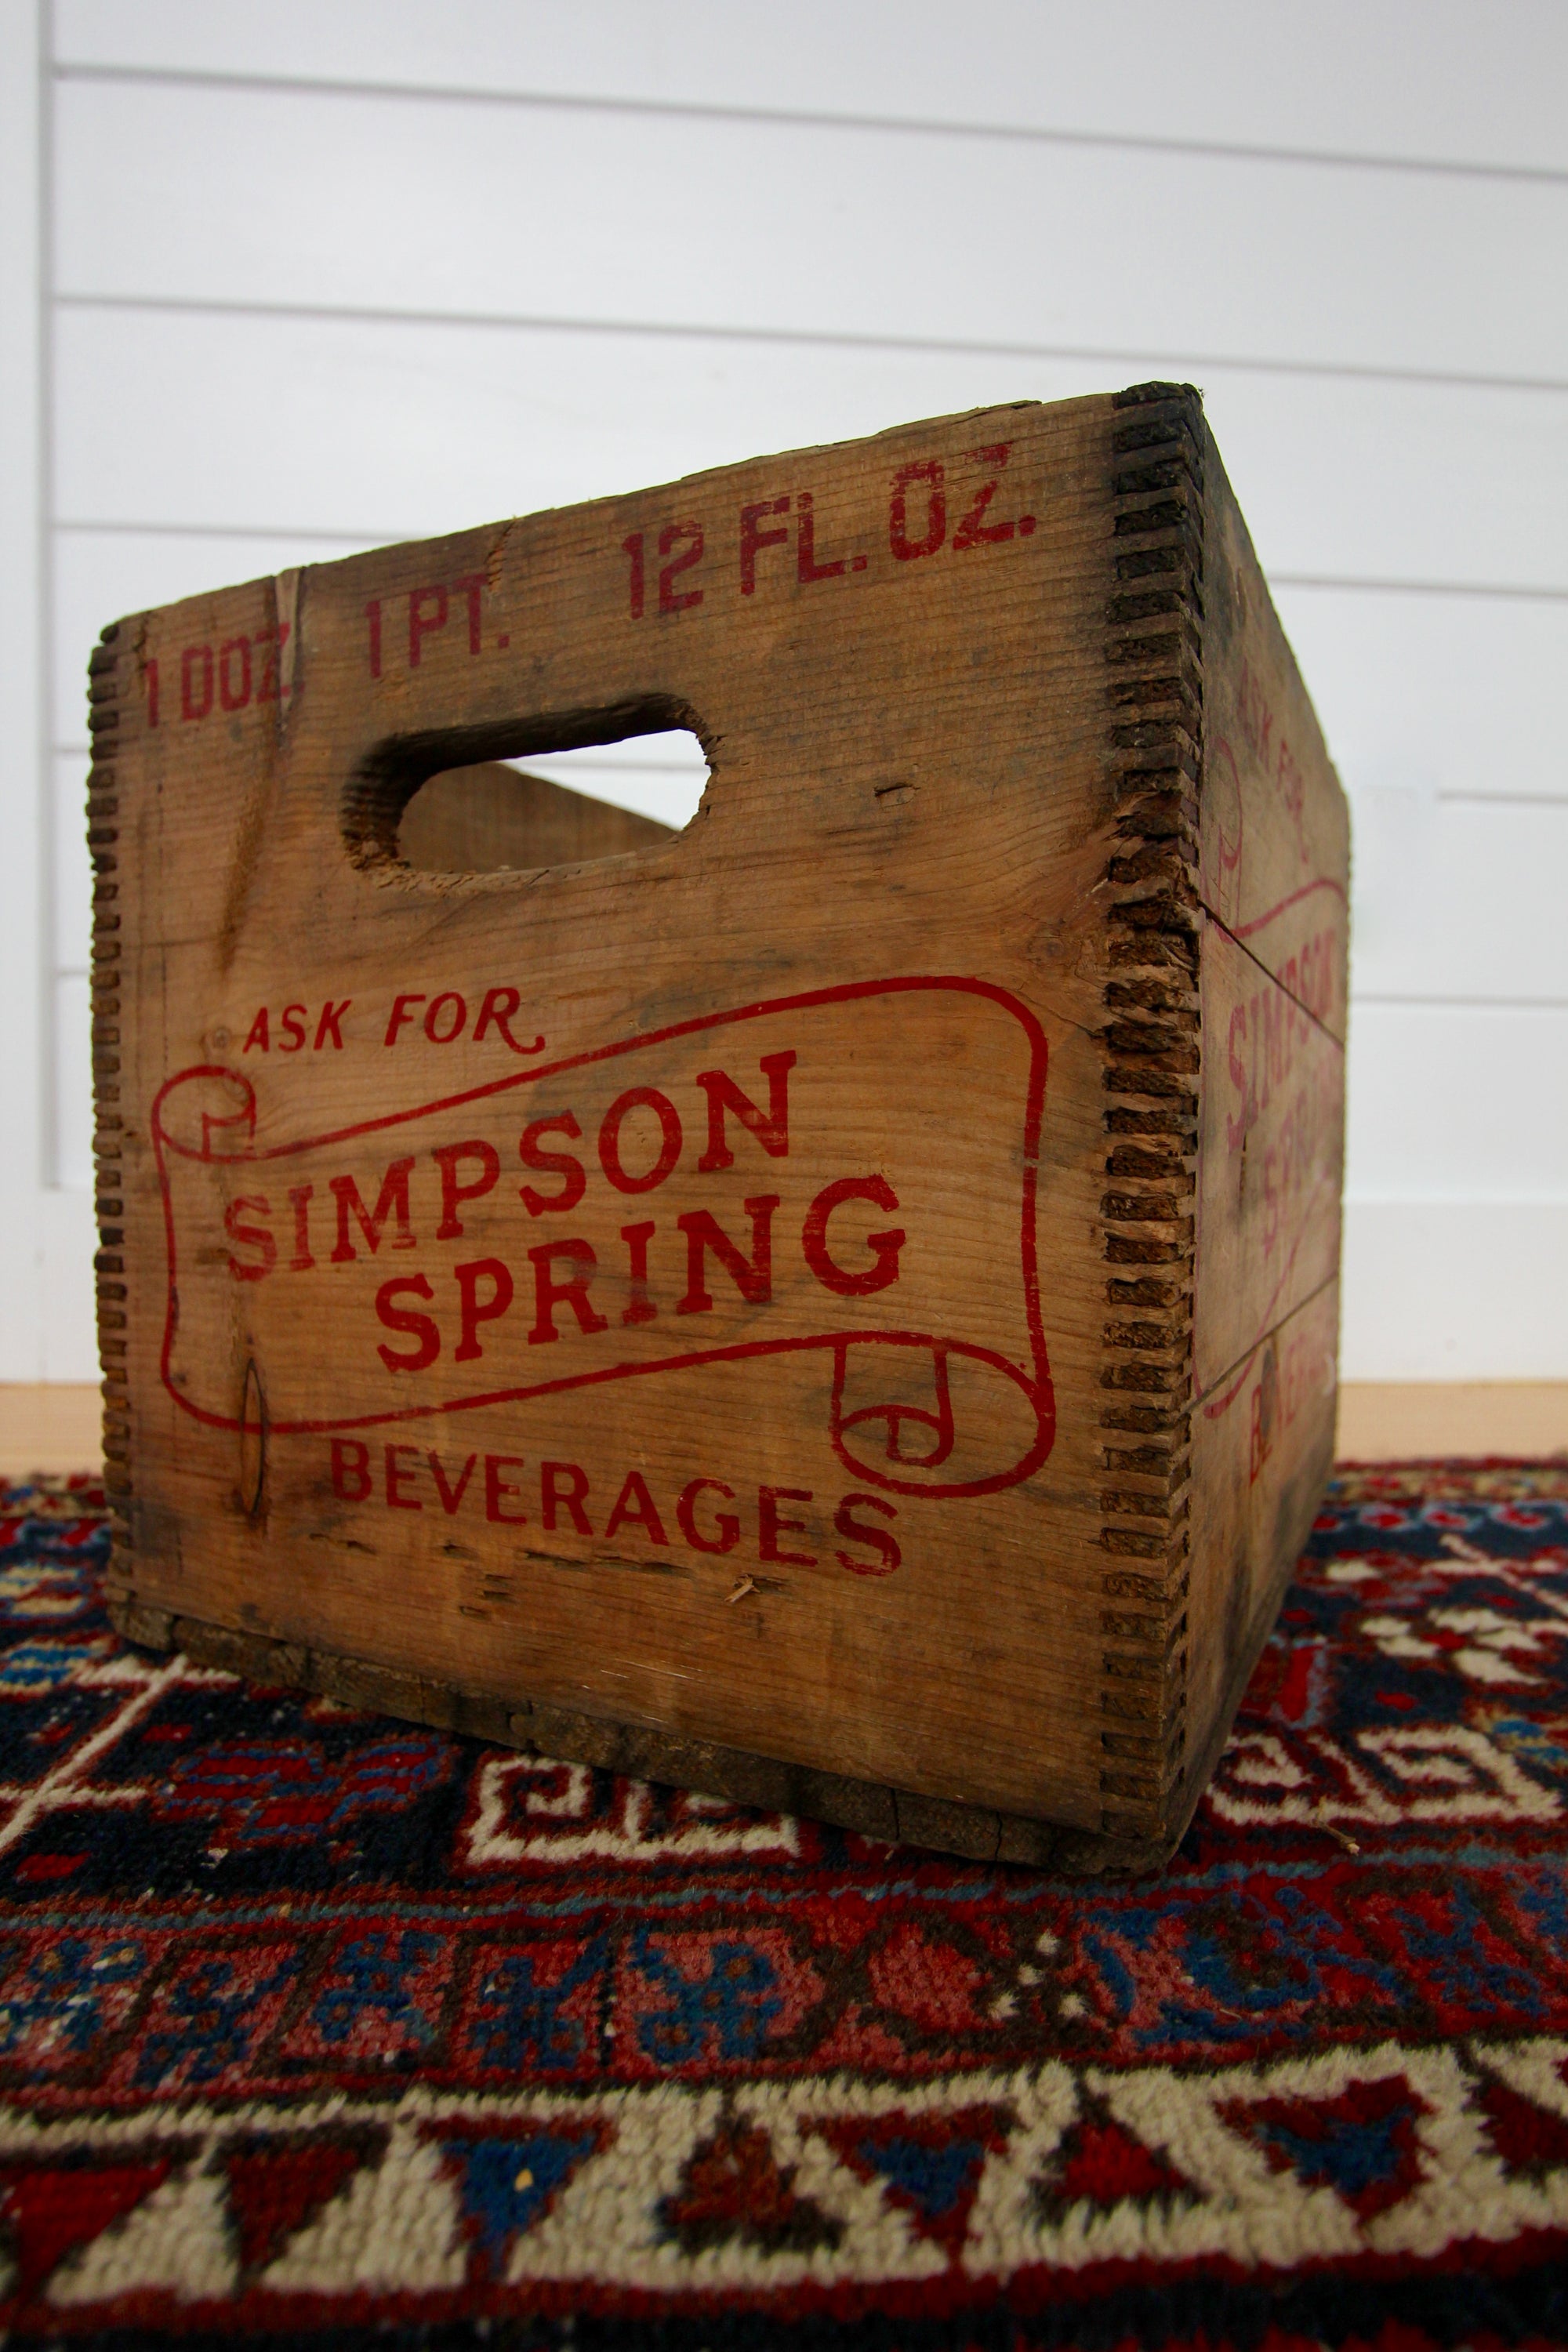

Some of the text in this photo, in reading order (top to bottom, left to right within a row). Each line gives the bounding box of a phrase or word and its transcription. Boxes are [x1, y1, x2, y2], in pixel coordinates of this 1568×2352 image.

[143, 657, 162, 729] 1
[364, 599, 383, 679] 1
[408, 572, 510, 668] PT.
[621, 519, 705, 621] 12
[739, 490, 868, 597] FL.
[887, 440, 1037, 562] OZ.
[241, 986, 546, 1056] ASK FOR
[223, 1048, 798, 1283] SIMPSON
[373, 1172, 907, 1374] SPRING
[329, 1438, 903, 1577] BEVERAGES
